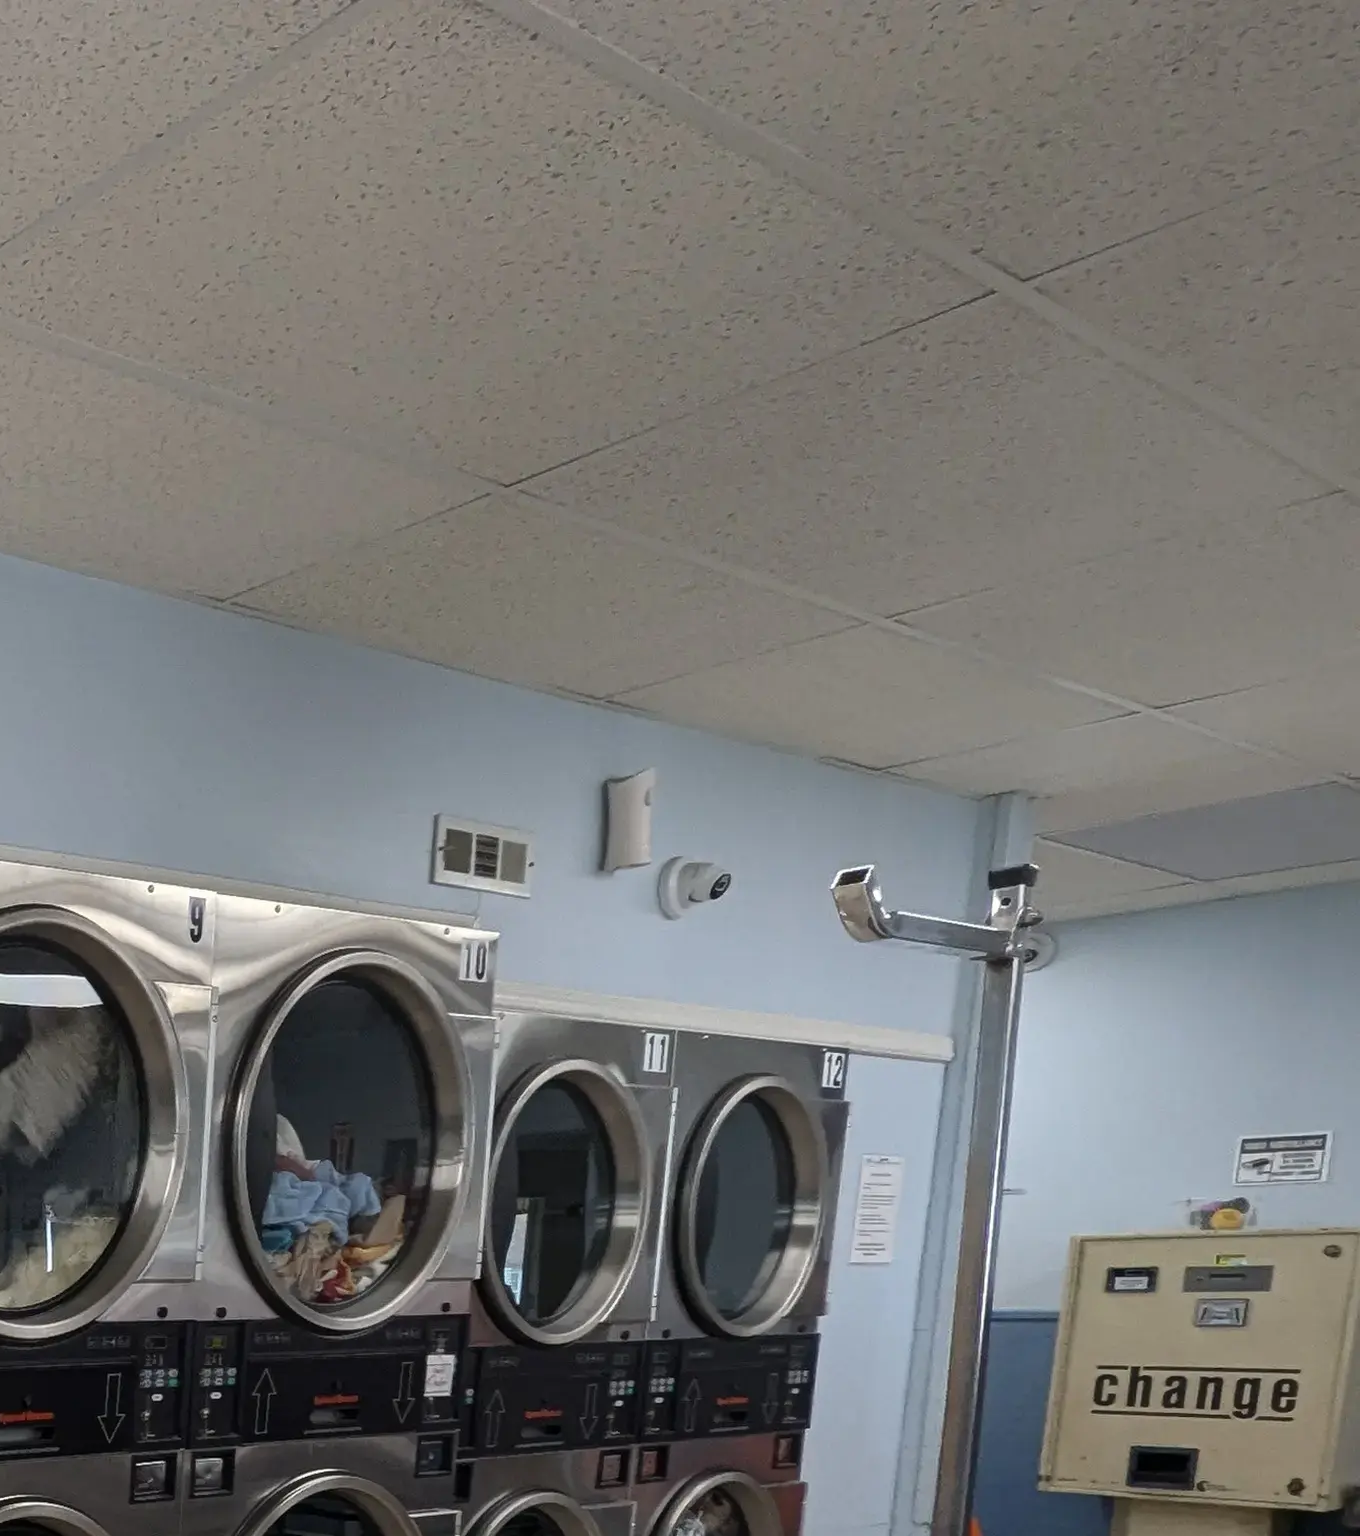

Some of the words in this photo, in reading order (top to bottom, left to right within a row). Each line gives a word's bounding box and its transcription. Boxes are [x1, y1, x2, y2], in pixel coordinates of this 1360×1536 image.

[190, 900, 204, 943] 9
[465, 942, 487, 980] 10
[649, 1035, 667, 1071] 11
[827, 1054, 843, 1087] 12
[1092, 1366, 1299, 1419] change
